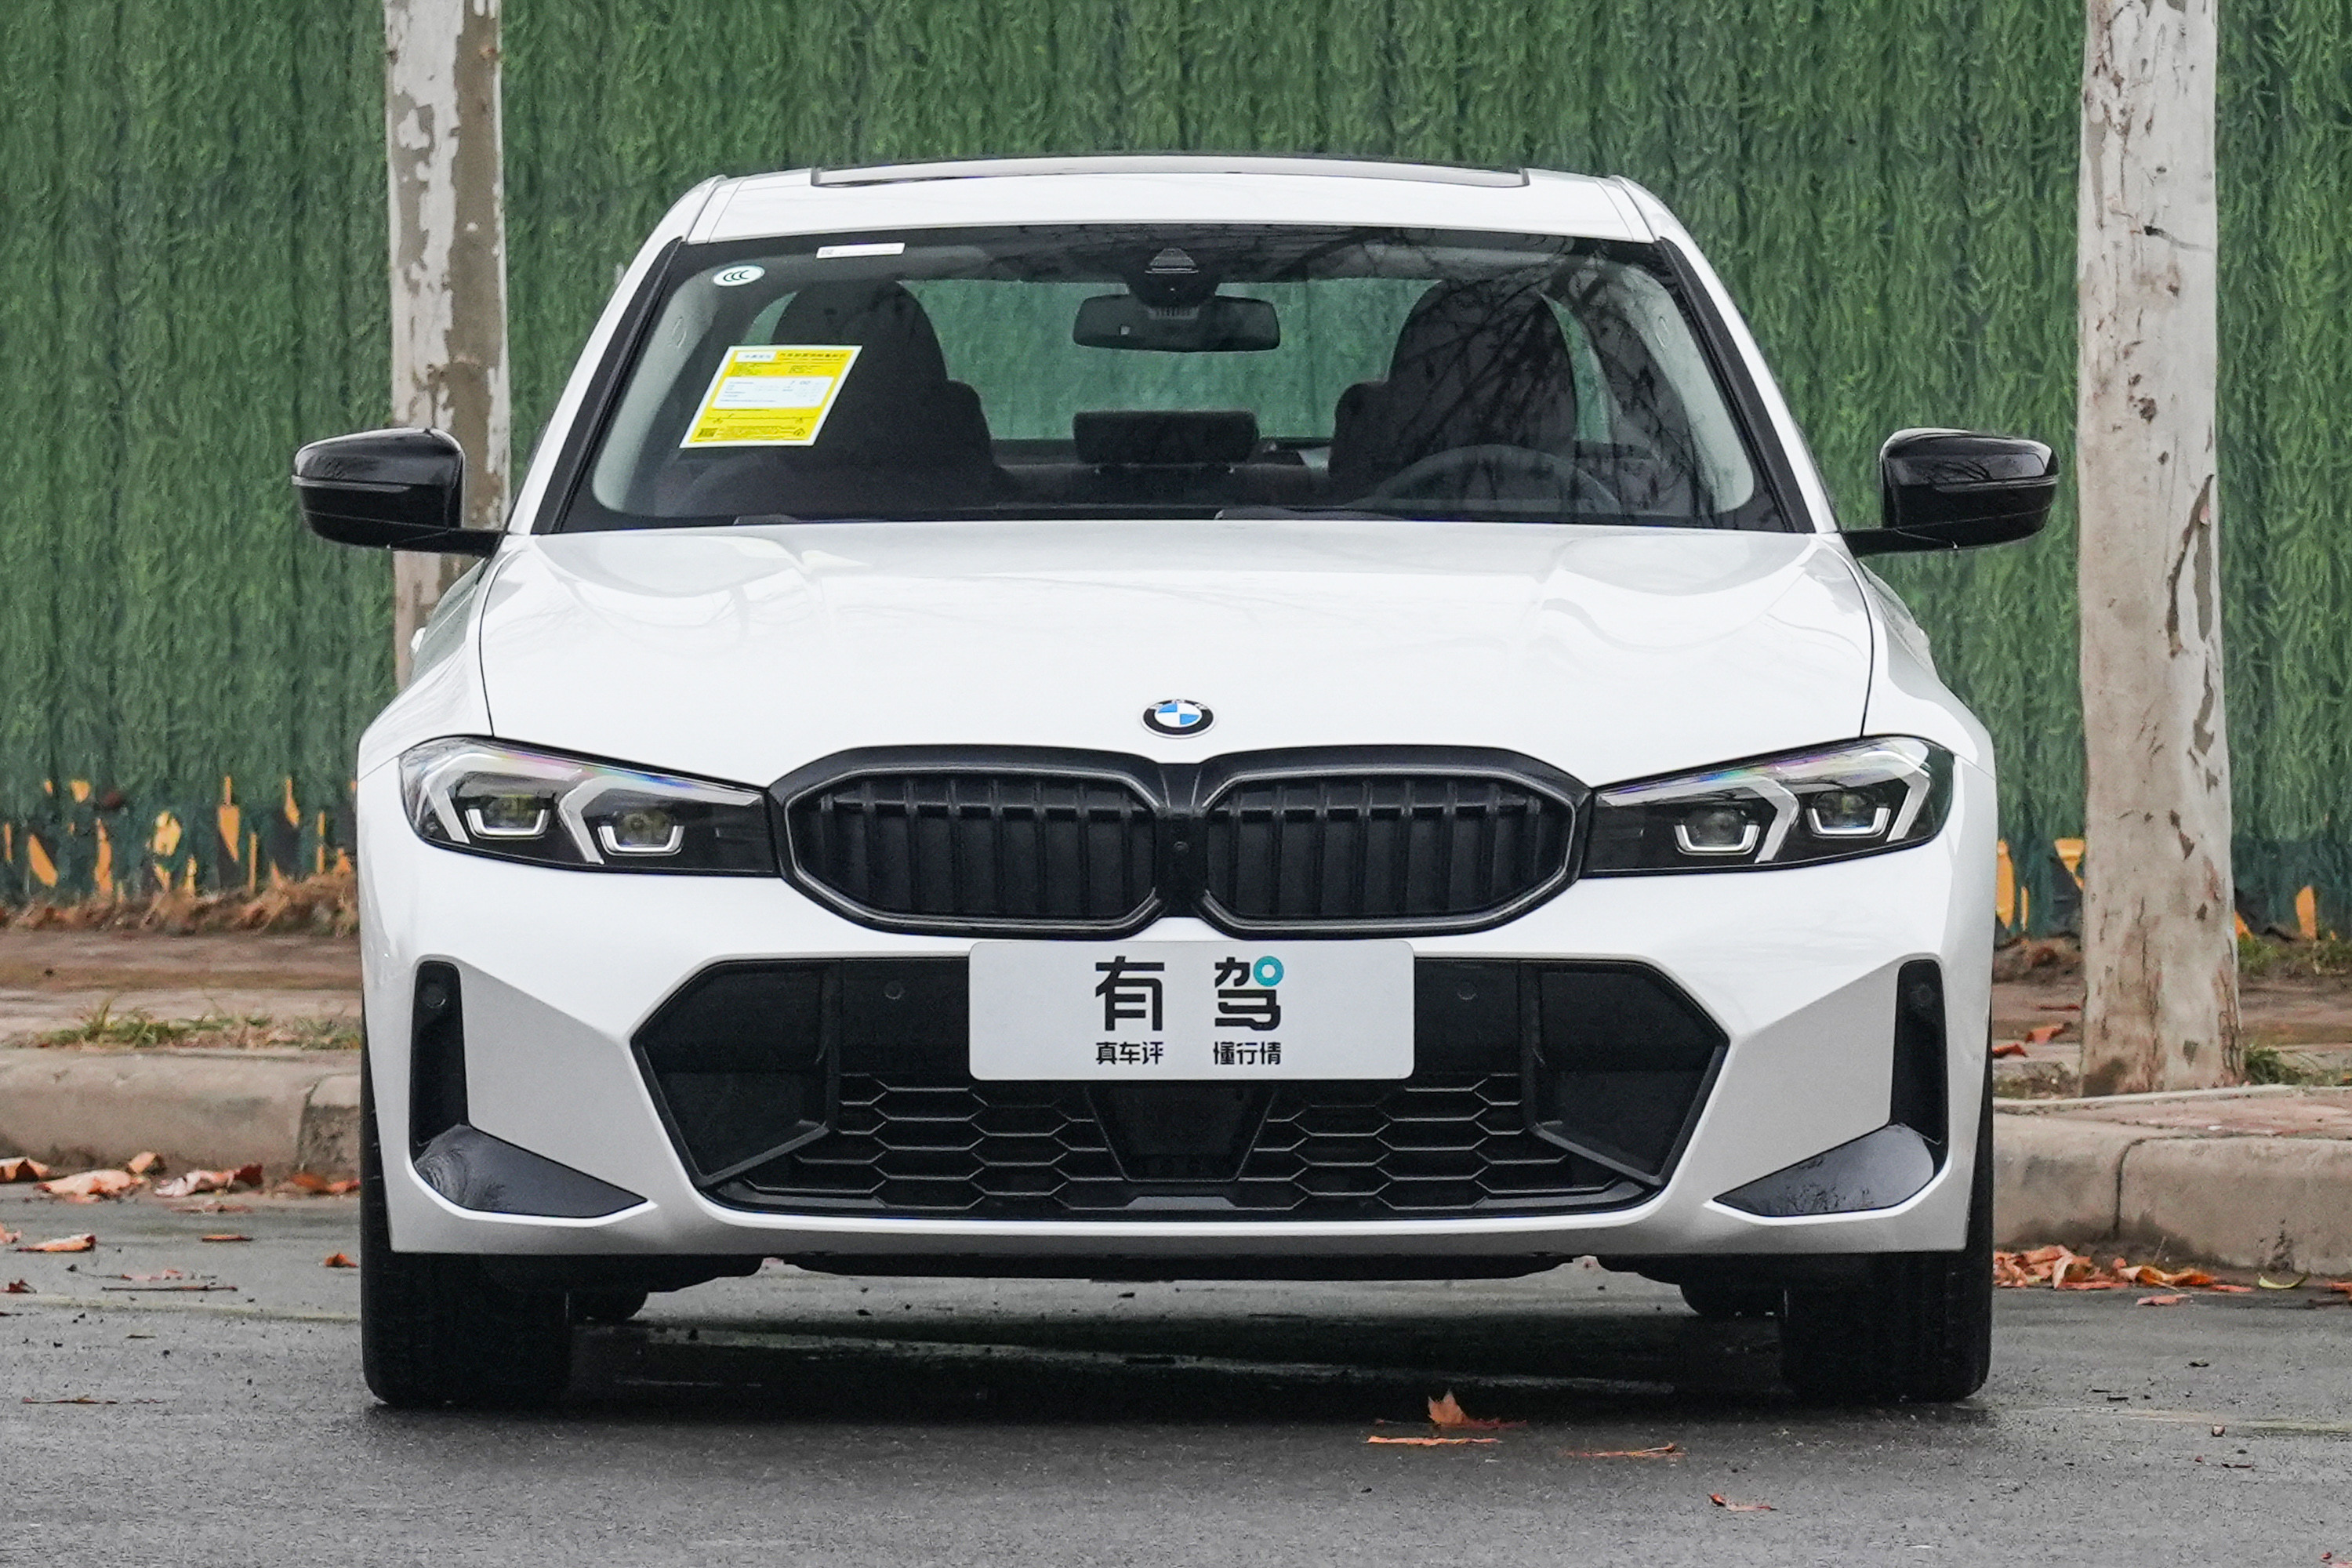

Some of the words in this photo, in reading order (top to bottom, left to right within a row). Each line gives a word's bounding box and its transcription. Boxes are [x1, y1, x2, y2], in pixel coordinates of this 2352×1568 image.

[723, 269, 750, 282] CCC
[1096, 1041, 1164, 1065] 真车评
[1213, 1041, 1282, 1065] 懂行情
